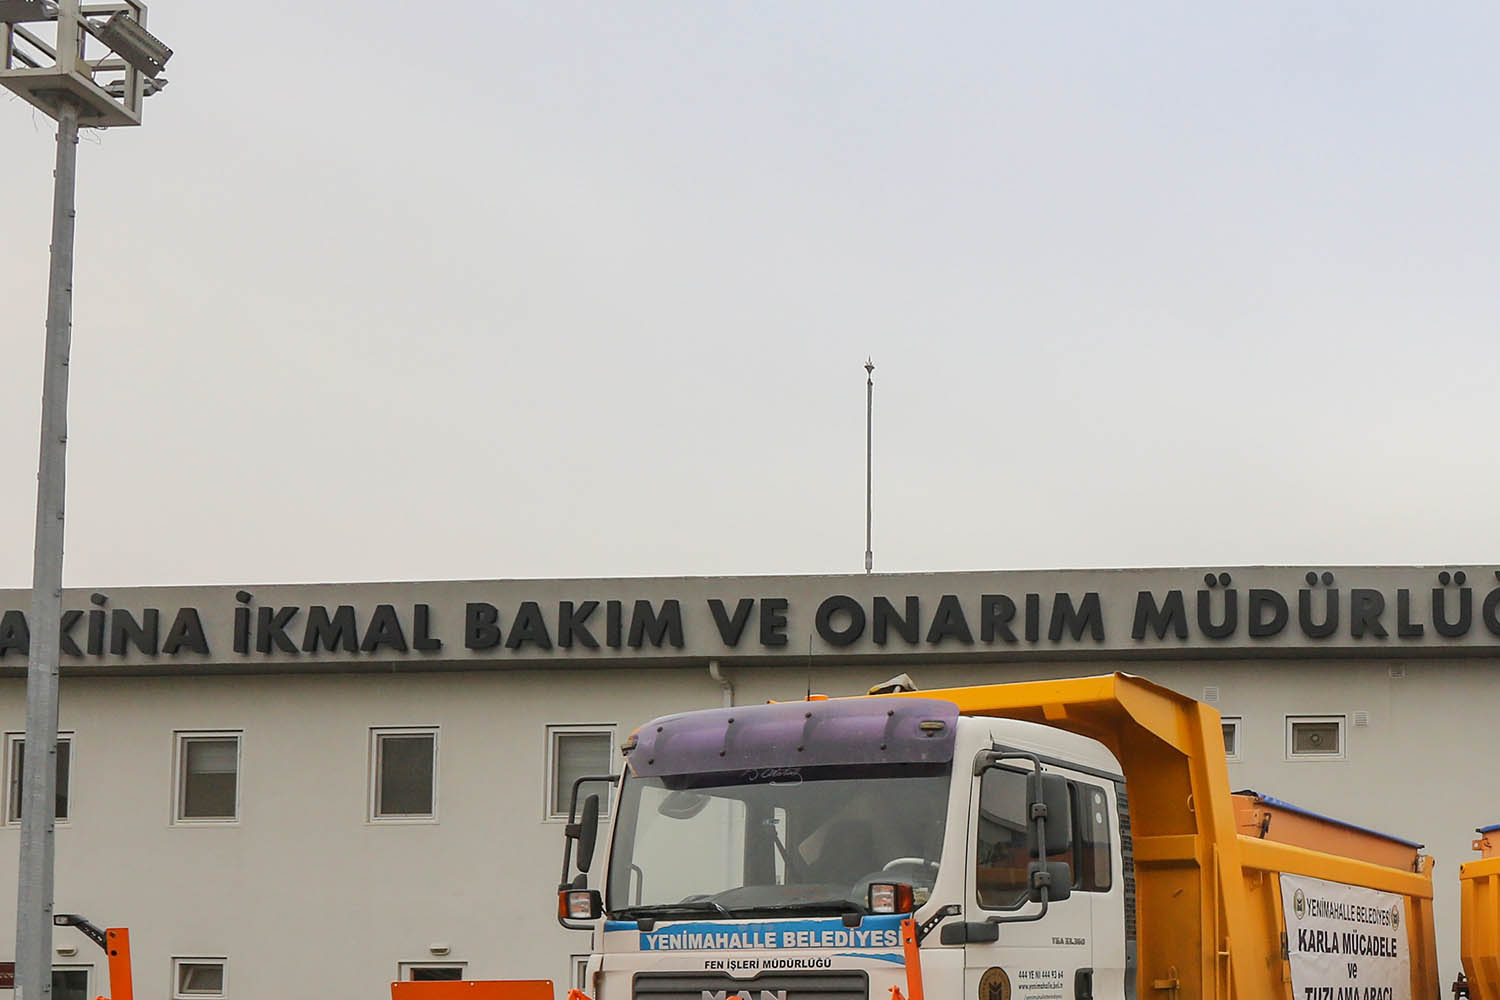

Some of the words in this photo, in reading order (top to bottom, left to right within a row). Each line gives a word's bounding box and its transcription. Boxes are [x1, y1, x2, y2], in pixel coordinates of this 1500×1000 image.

[233, 591, 442, 653] İKMAL
[464, 600, 685, 650] BAKIM
[707, 598, 788, 647] VE
[815, 592, 1105, 645] ONARIM
[1306, 897, 1356, 922] YENİMAHALLE
[1356, 906, 1392, 927] BELEDİYESİ
[646, 930, 777, 950] YENİMAHALLE
[782, 926, 904, 948] BELEDİYESİ
[1298, 928, 1340, 954] KARLA
[1342, 929, 1398, 958] MÜCADELE
[704, 960, 724, 969] FEN
[727, 958, 760, 971] İŞLERİ
[762, 957, 832, 969] MÜDÜRLÜĞÜ
[1347, 963, 1358, 978] ve
